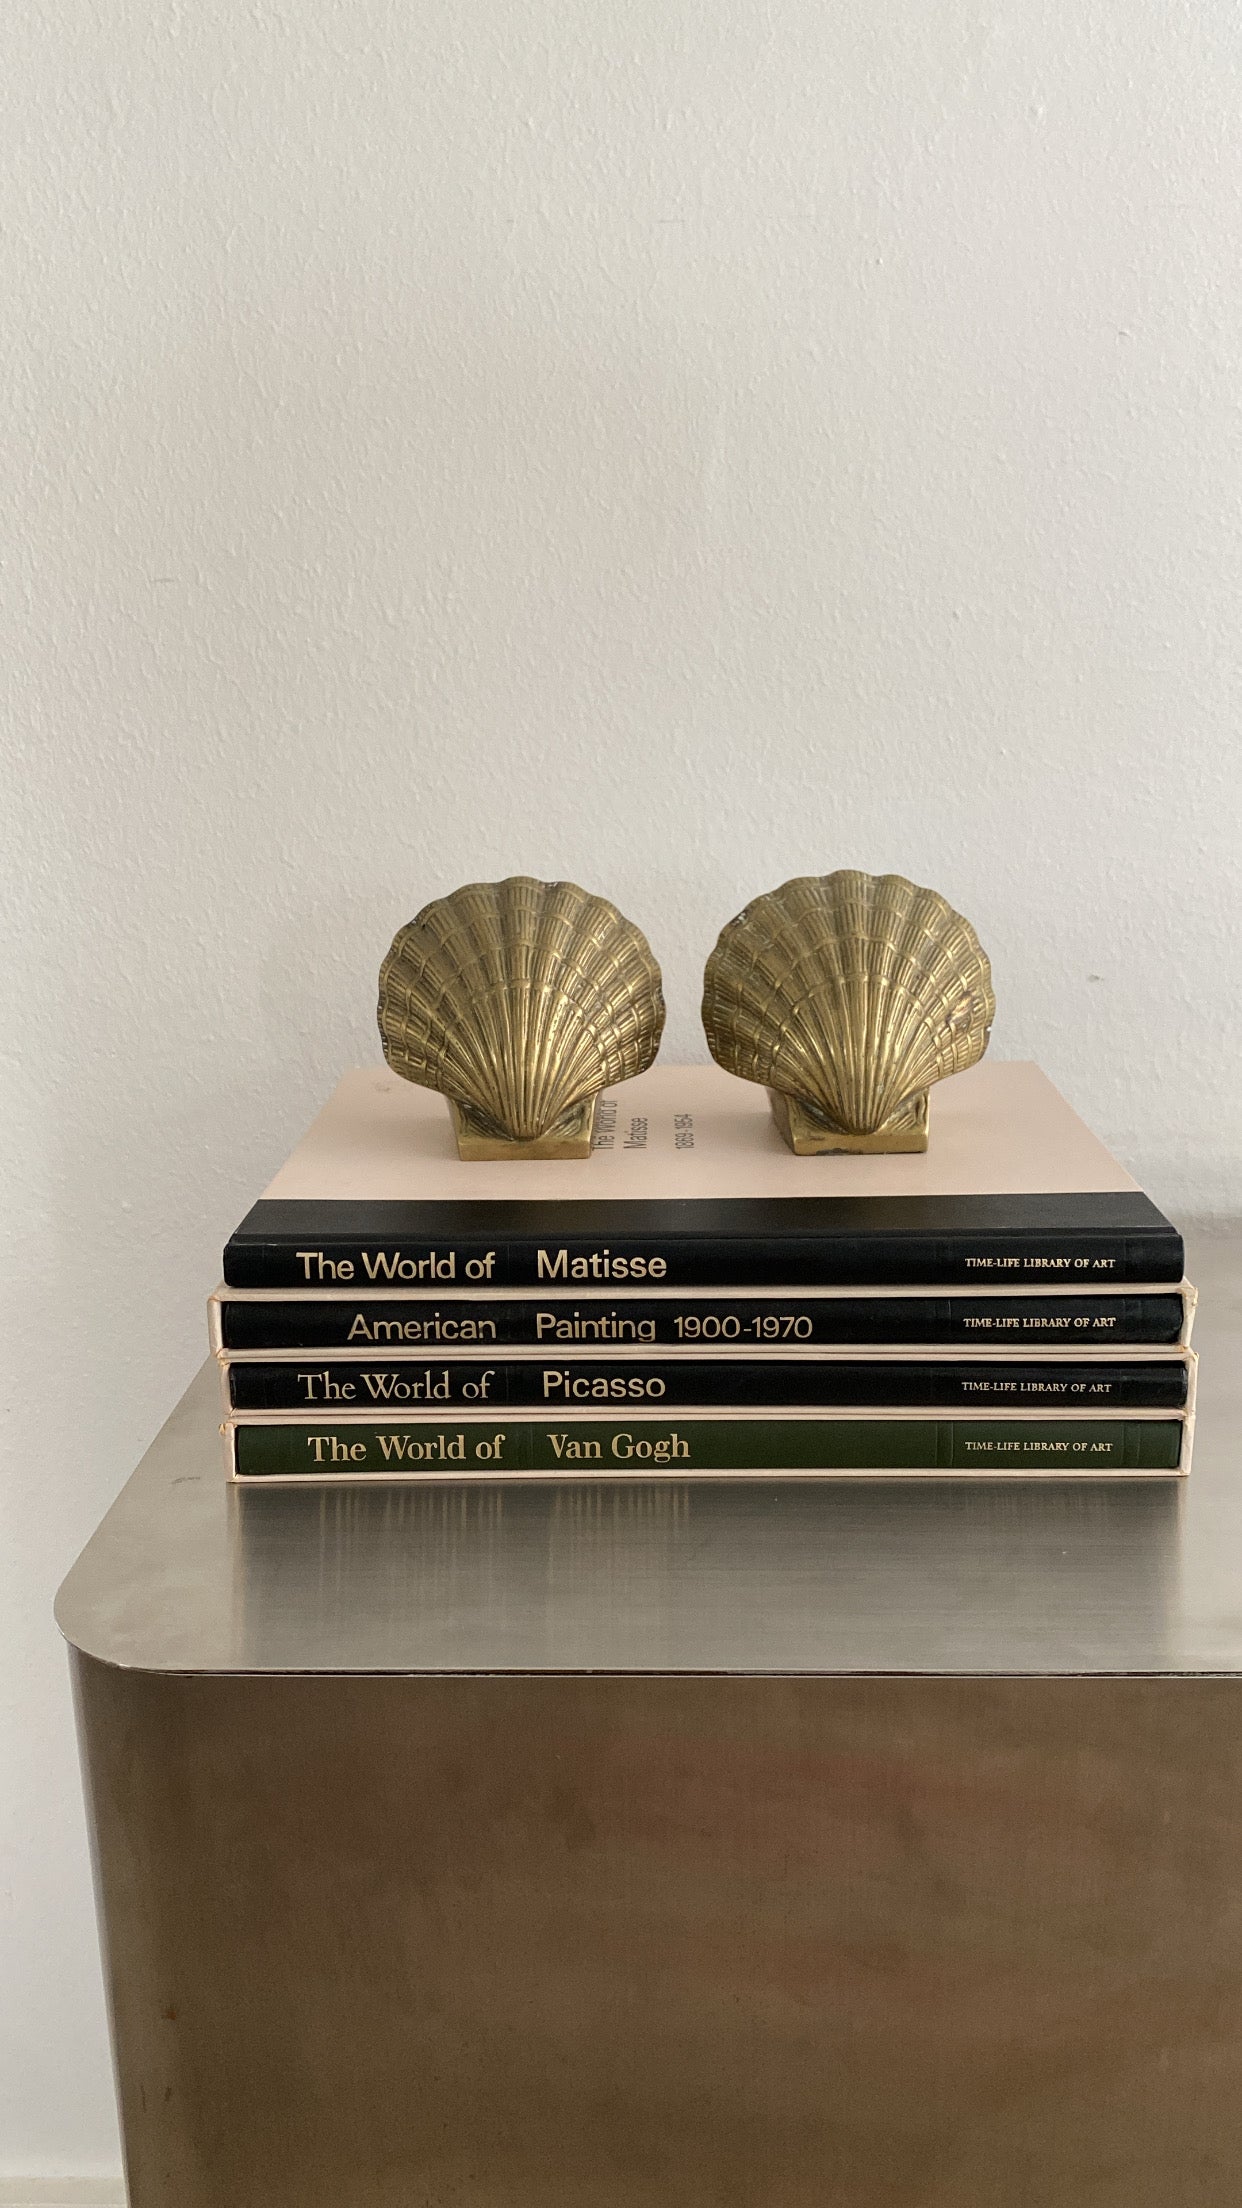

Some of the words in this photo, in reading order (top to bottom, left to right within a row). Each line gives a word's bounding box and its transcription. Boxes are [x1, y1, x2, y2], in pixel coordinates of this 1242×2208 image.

[591, 1135, 615, 1151] The
[623, 1117, 648, 1149] Matisse
[296, 1251, 355, 1280] The
[361, 1251, 456, 1280] World
[465, 1251, 496, 1279] of
[537, 1249, 667, 1279] Matisse
[964, 1257, 1021, 1269] TIME-LIFE
[1023, 1257, 1072, 1269] LIBRARY
[1074, 1257, 1090, 1269] OF
[1092, 1257, 1117, 1269] ART
[347, 1312, 497, 1341] American
[536, 1311, 656, 1342] Painting
[674, 1315, 813, 1338] 1900-1970
[963, 1317, 1020, 1328] TIME-LIFE
[1022, 1317, 1072, 1328] LIBRARY
[1074, 1317, 1091, 1328] OF
[1092, 1316, 1117, 1328] ART
[297, 1371, 356, 1400] The
[361, 1370, 451, 1400] World
[462, 1370, 496, 1399] of
[543, 1370, 666, 1398] Picasso
[961, 1381, 1018, 1392] TIME-LIFE
[1019, 1381, 1069, 1393] LIBRARY
[1070, 1382, 1087, 1393] OF
[1088, 1382, 1113, 1393] ART
[307, 1436, 367, 1462] The
[375, 1434, 467, 1461] World
[475, 1433, 506, 1460] of
[546, 1433, 603, 1459] Van
[611, 1433, 691, 1463] Gogh
[964, 1441, 1021, 1452] TIME-LIFE
[1022, 1441, 1071, 1452] LIBRARY
[1072, 1441, 1088, 1452] OF
[1090, 1441, 1114, 1452] ART
